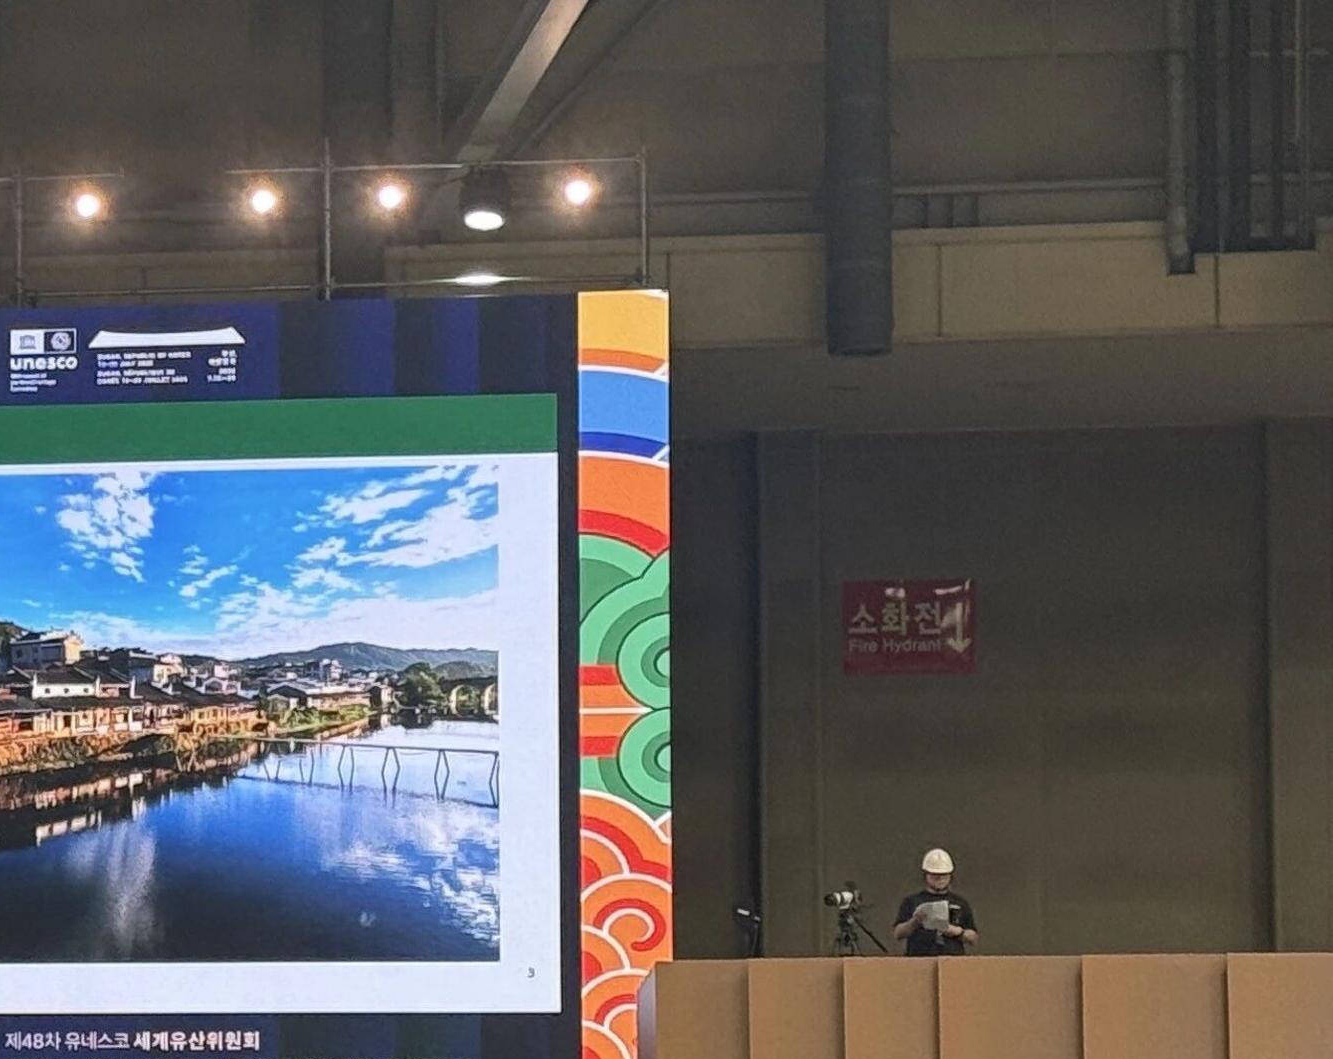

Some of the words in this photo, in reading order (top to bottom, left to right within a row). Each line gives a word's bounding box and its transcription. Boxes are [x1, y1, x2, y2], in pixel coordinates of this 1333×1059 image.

[9, 356, 78, 370] unesco
[848, 600, 941, 636] 소화전
[848, 638, 879, 652] Fire
[883, 638, 941, 653] Hydrant
[4, 1032, 62, 1051] 제48차
[64, 1032, 130, 1051] 유네스코
[133, 1031, 261, 1051] 세계유산위원회
